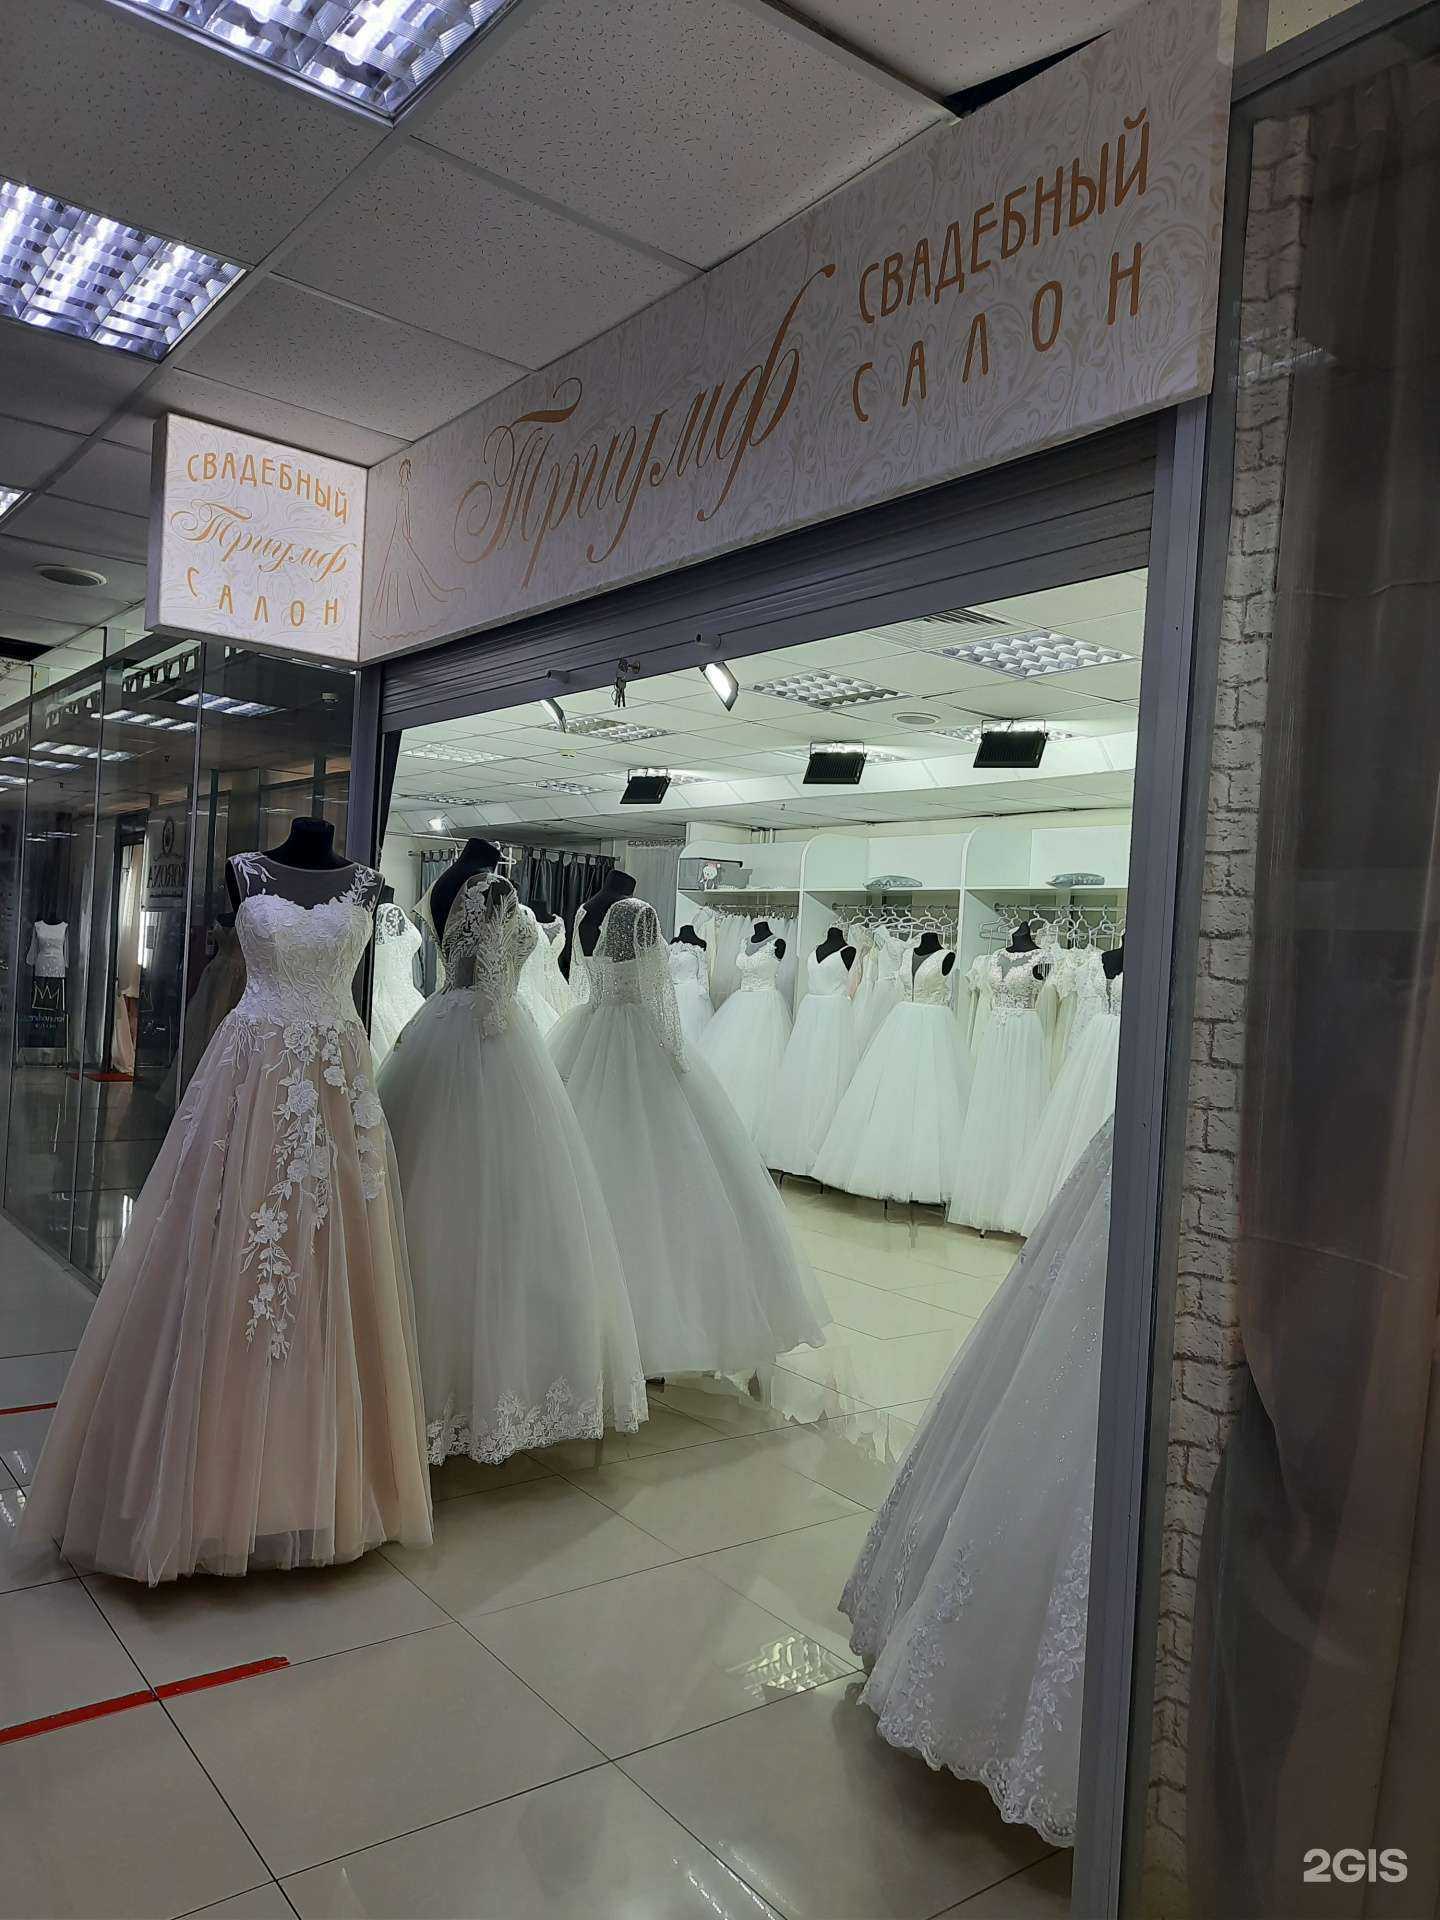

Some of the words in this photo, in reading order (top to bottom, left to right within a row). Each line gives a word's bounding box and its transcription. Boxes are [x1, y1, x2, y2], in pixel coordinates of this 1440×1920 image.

[859, 108, 1150, 324] СВАДЕБНЫЙ
[852, 242, 1143, 422] САЛОН
[187, 452, 350, 524] СВАДЕБНЫЙ
[453, 263, 836, 591] Триумф
[170, 499, 358, 583] Триумф
[187, 566, 339, 628] САЛОН
